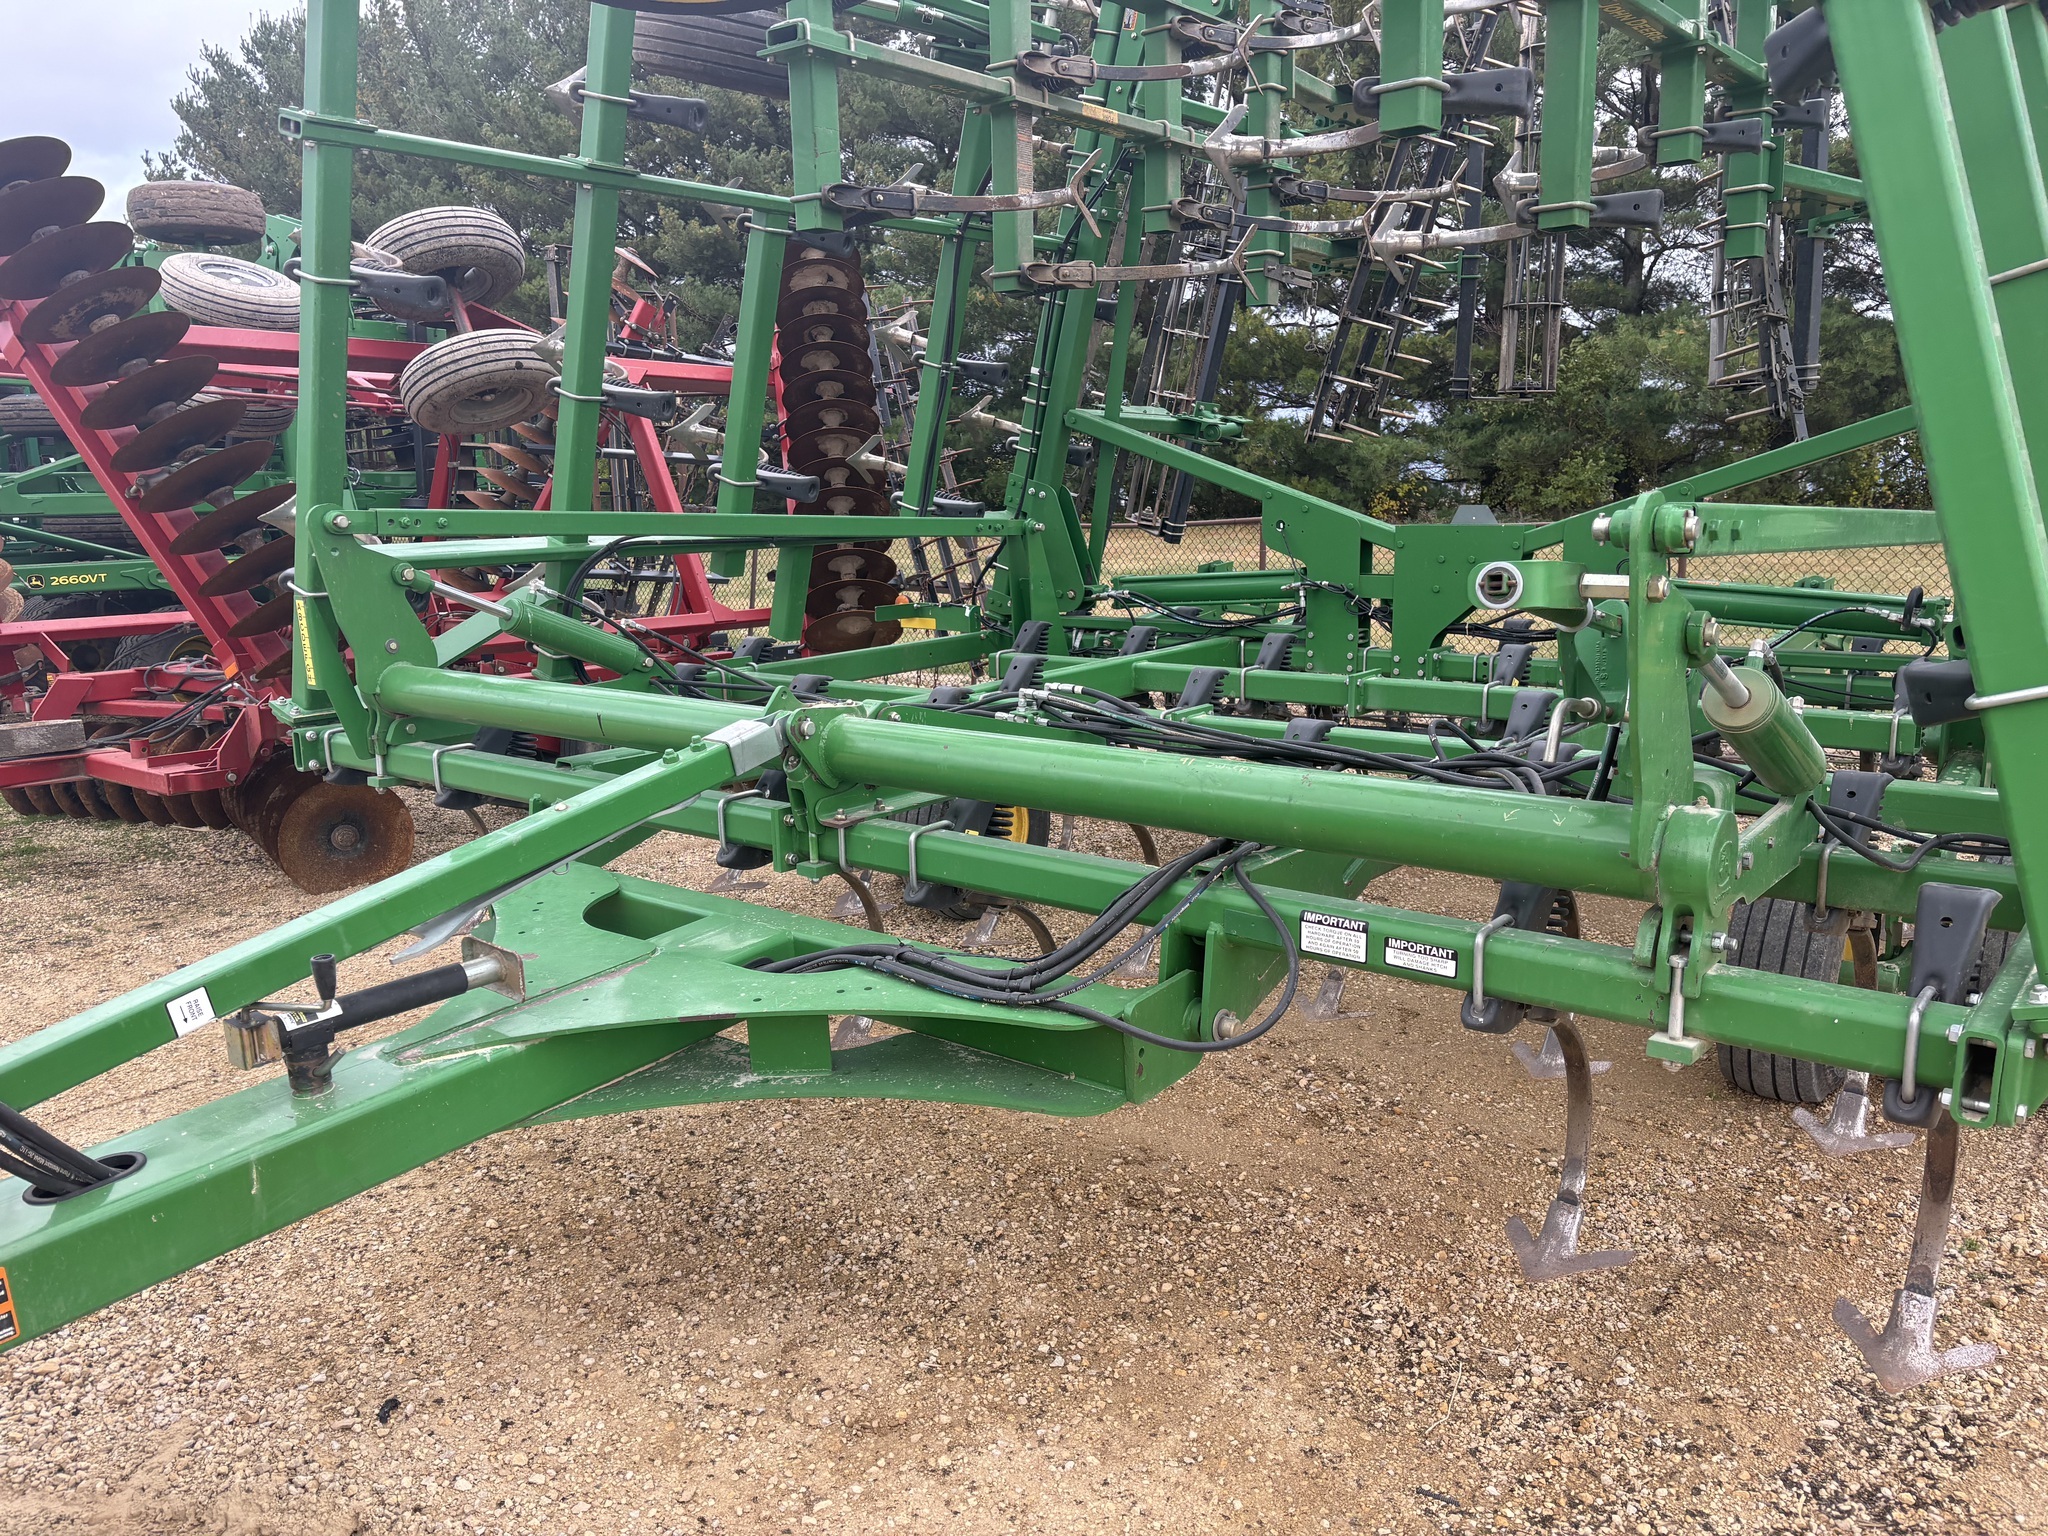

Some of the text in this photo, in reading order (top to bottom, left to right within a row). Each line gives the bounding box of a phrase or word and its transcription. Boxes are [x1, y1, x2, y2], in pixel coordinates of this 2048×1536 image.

[1599, 3, 1668, 42] JOHN DEERE
[50, 573, 108, 586] 2660VT
[1303, 911, 1366, 931] IMPORTANT
[1306, 934, 1323, 942] HOURS
[1332, 939, 1361, 949] OPERATION
[1388, 938, 1454, 959] IMPORTANT
[1332, 950, 1360, 959] OPERATION
[1393, 950, 1416, 958] TURNING
[1407, 958, 1429, 966] DAMAGE
[185, 1001, 198, 1021] FRONT
[192, 999, 204, 1017] RAISE
